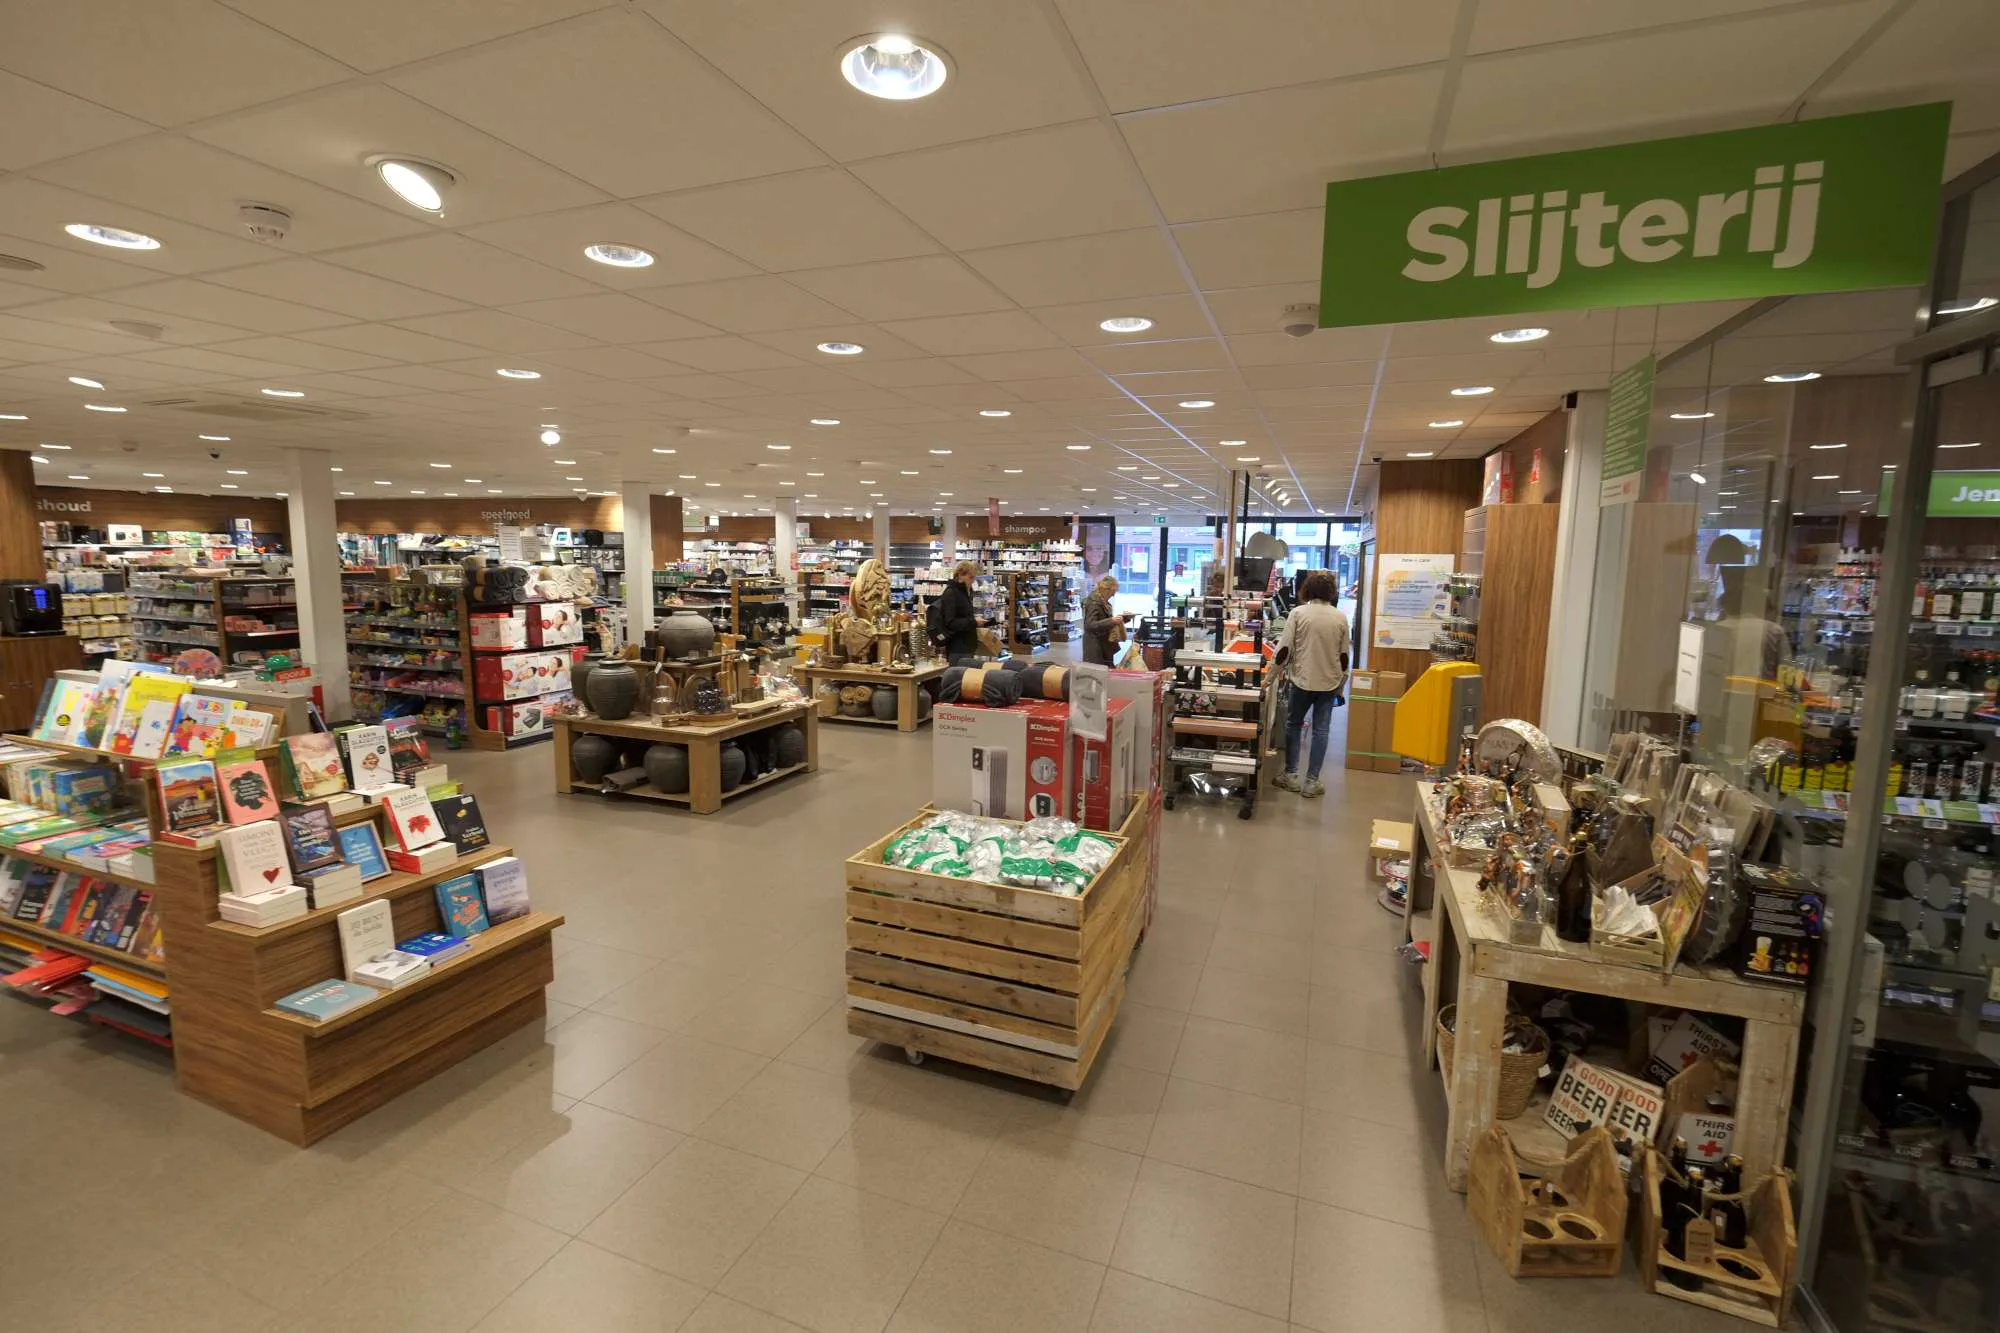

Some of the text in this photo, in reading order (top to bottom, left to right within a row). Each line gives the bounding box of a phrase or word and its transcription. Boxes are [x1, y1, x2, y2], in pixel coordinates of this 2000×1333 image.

[1401, 160, 1824, 289] Slijterij
[481, 509, 530, 521] speelgoed
[1004, 524, 1046, 535] shampoo
[1688, 1022, 1727, 1050] THIRST
[1691, 1039, 1711, 1055] AID
[1568, 1060, 1616, 1097] A GOOD
[1560, 1073, 1607, 1119] BEER
[1547, 1104, 1575, 1133] BEER
[1570, 1103, 1586, 1121] OPEN
[1703, 1129, 1727, 1139] AID
